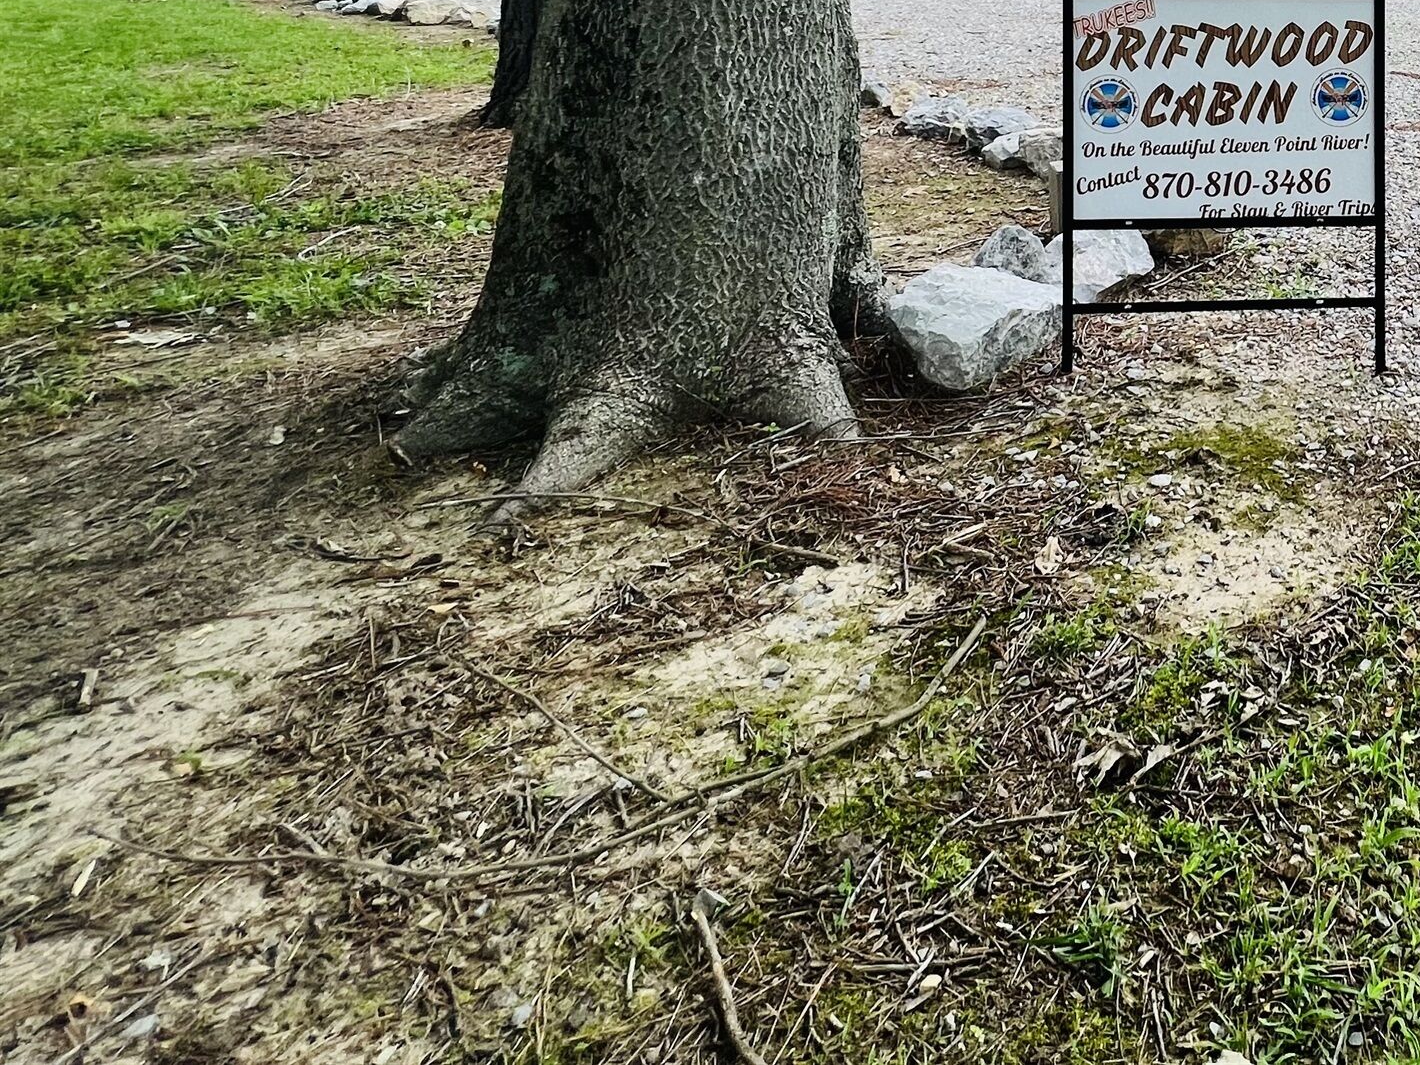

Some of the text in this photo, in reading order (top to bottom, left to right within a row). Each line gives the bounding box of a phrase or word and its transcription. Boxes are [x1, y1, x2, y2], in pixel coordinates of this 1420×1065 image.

[1075, 20, 1374, 72] DRIFTWOOD
[1140, 80, 1298, 128] CABIN
[1081, 133, 1371, 160] On the Beautiful Eleven Point River!
[1076, 165, 1332, 200] Contact 870-810-3486
[1199, 204, 1226, 218] For
[1273, 201, 1287, 218] &
[1291, 201, 1334, 217] River
